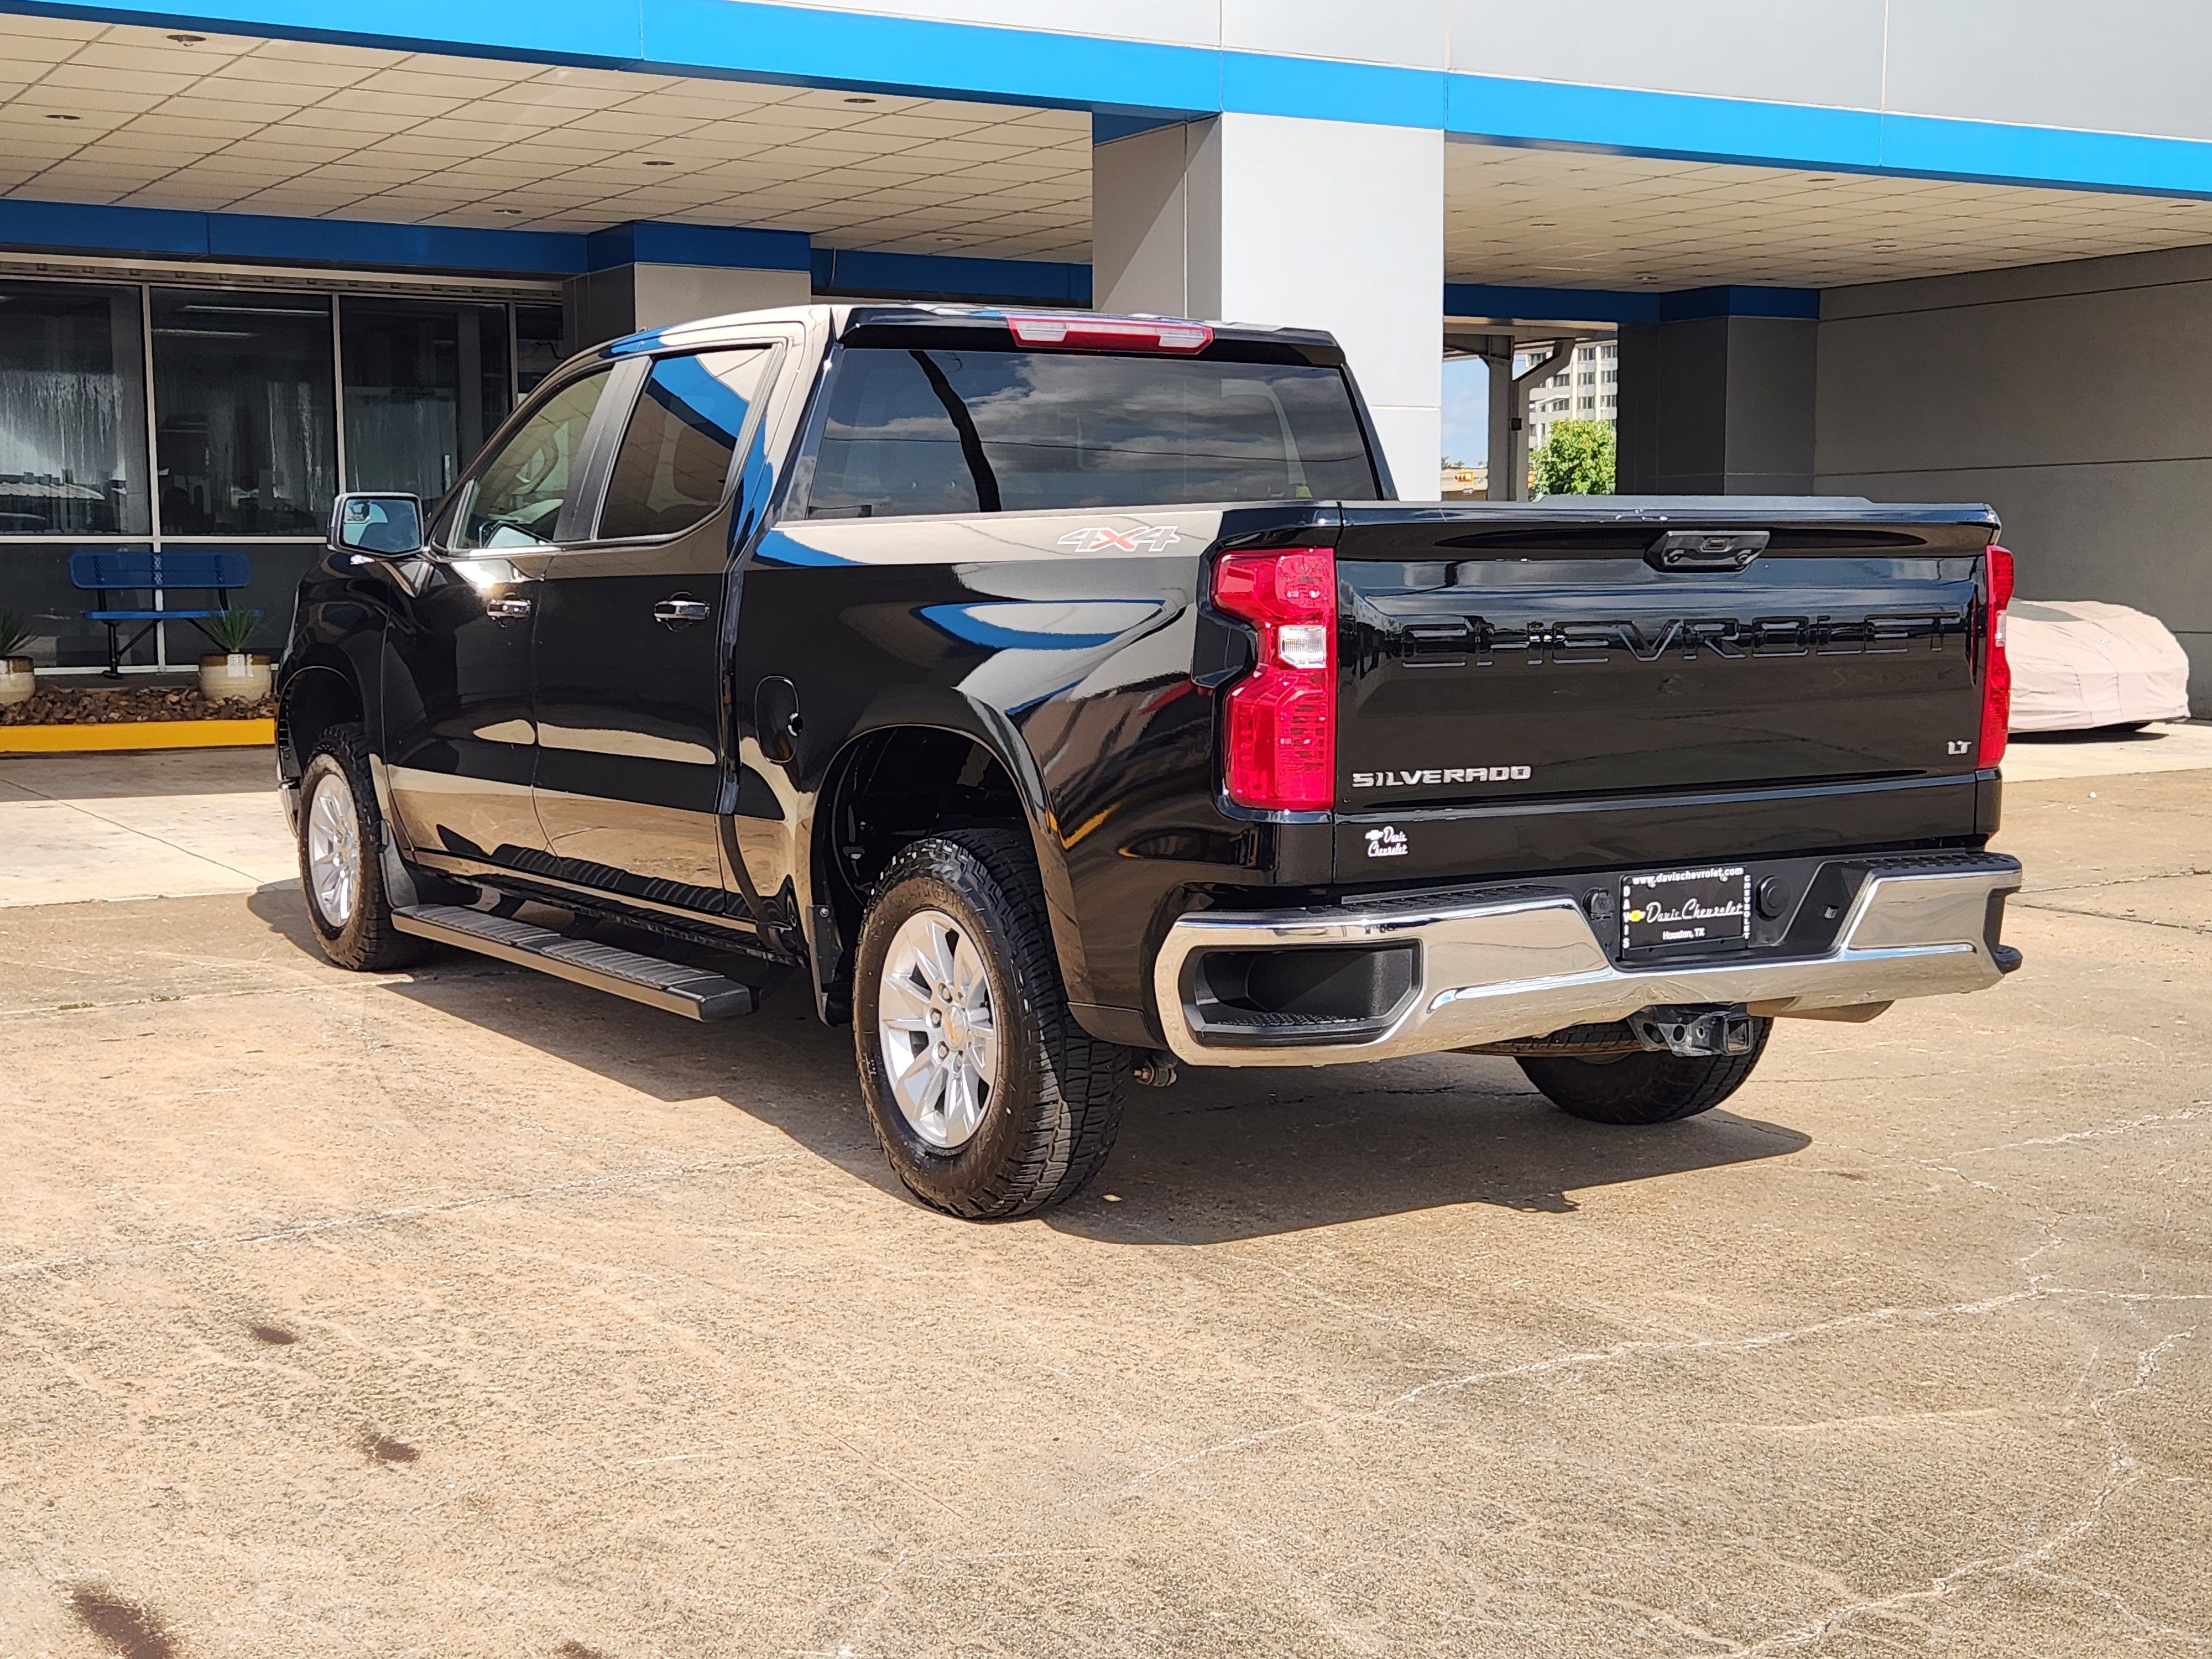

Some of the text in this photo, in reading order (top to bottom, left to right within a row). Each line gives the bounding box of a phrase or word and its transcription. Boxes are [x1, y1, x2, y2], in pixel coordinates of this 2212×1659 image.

[1402, 613, 1961, 668] CHEVROLET
[1947, 740, 1972, 755] LT
[1352, 765, 1531, 787] SILVERADO
[1632, 867, 1744, 885] www.davischevrolet.com
[1646, 898, 1744, 923] Davis Chevrolet
[1694, 927, 1705, 937] TX
